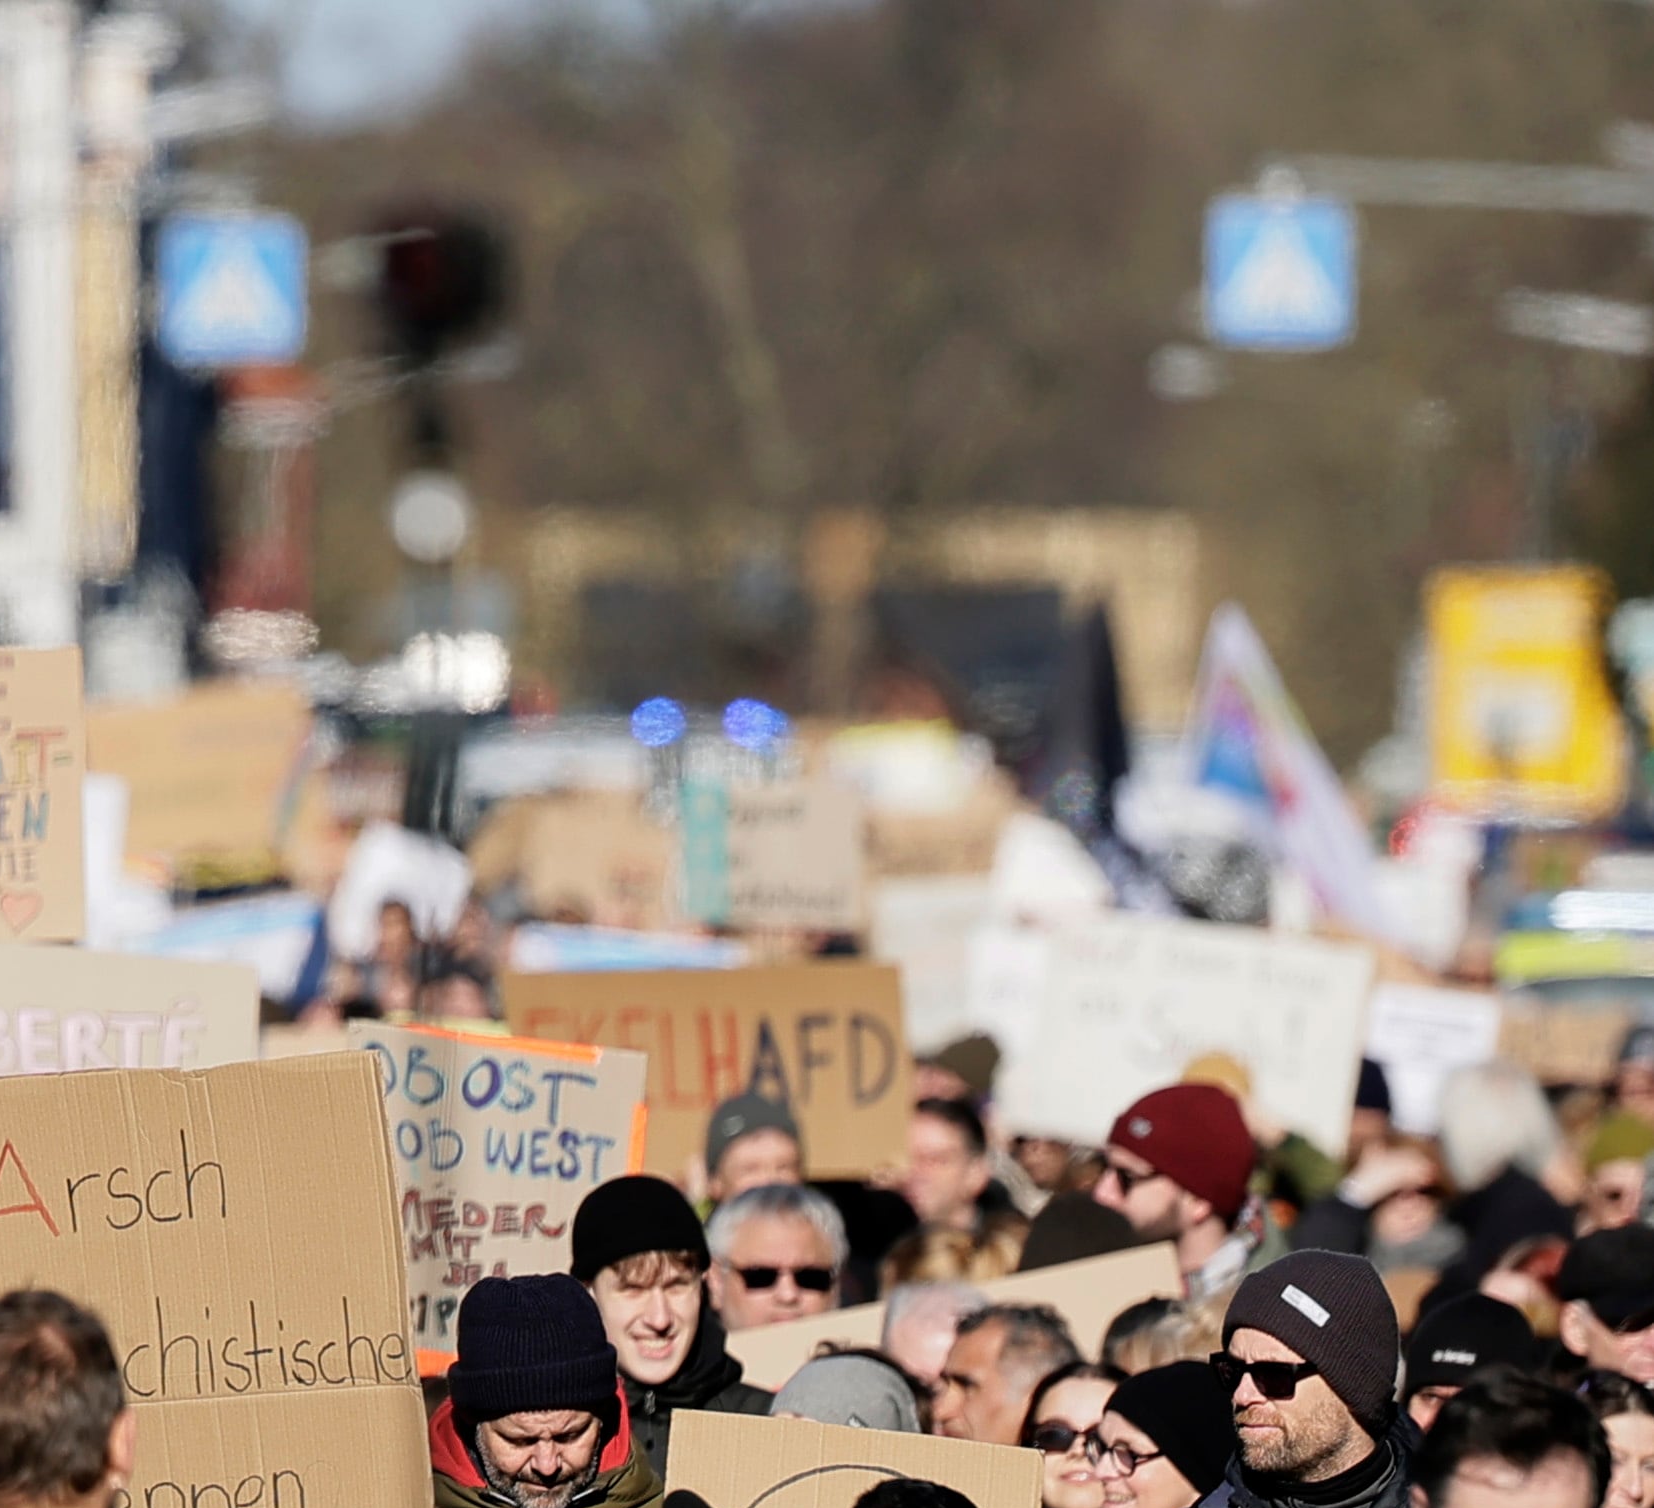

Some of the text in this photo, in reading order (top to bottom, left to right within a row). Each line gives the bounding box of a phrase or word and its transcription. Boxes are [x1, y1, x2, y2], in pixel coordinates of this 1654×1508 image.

[462, 1058, 598, 1126] OST
[523, 1006, 897, 1108] ELHAFD
[396, 1119, 617, 1182] OB WEST
[123, 1296, 411, 1398] chistische
